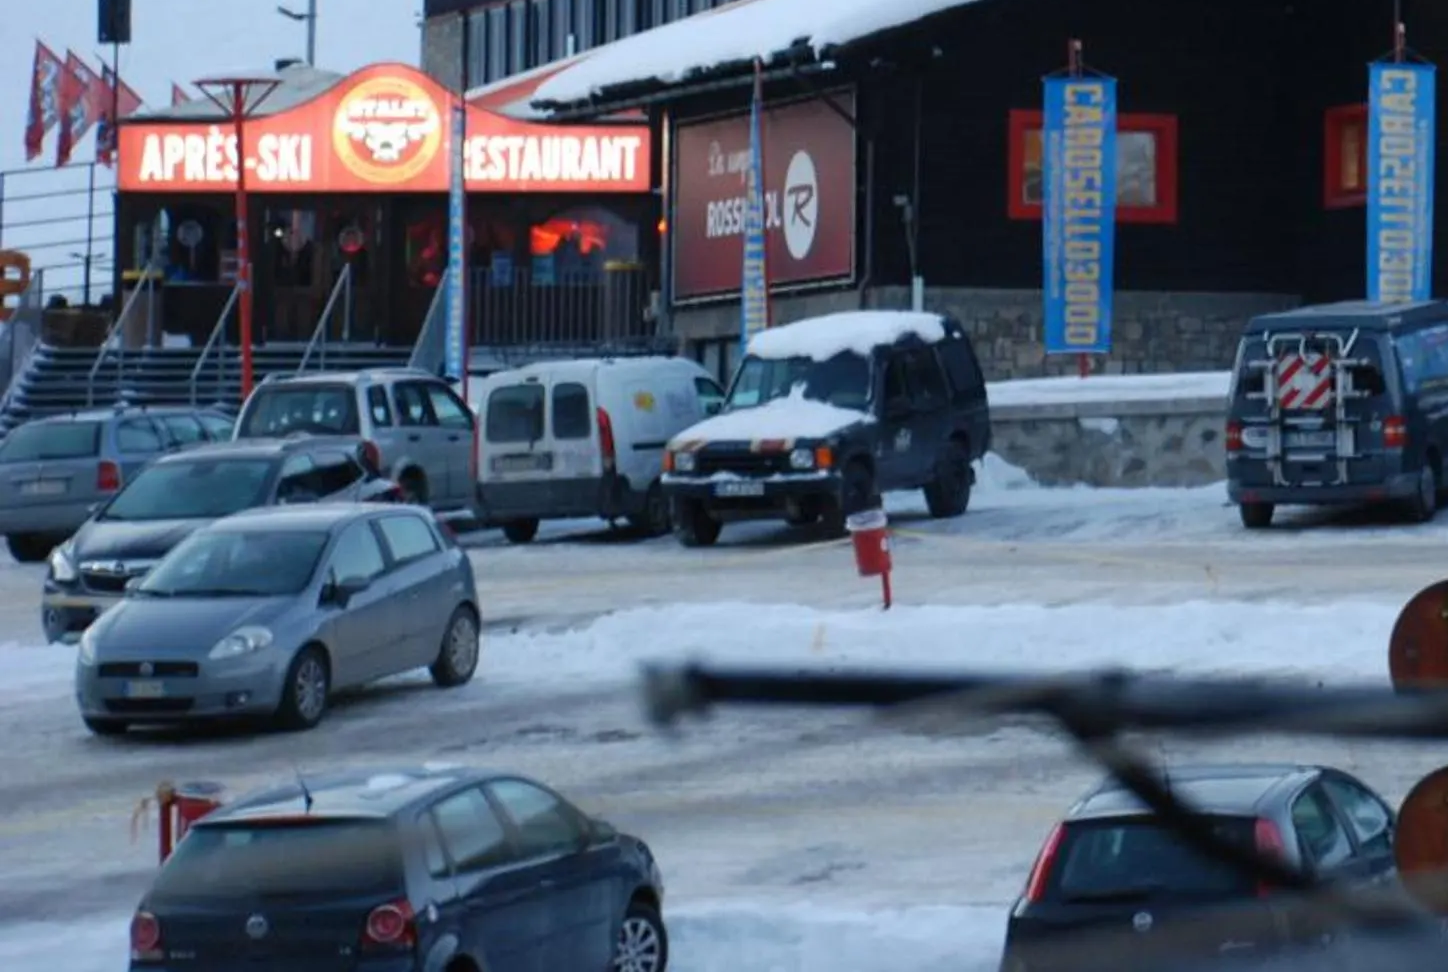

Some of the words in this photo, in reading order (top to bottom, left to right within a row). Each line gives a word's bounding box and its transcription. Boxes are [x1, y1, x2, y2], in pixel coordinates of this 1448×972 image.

[139, 125, 312, 181] APRÈS-SKI
[706, 191, 781, 238] ROSSIOL
[1064, 83, 1103, 345] CAROSELLO3000
